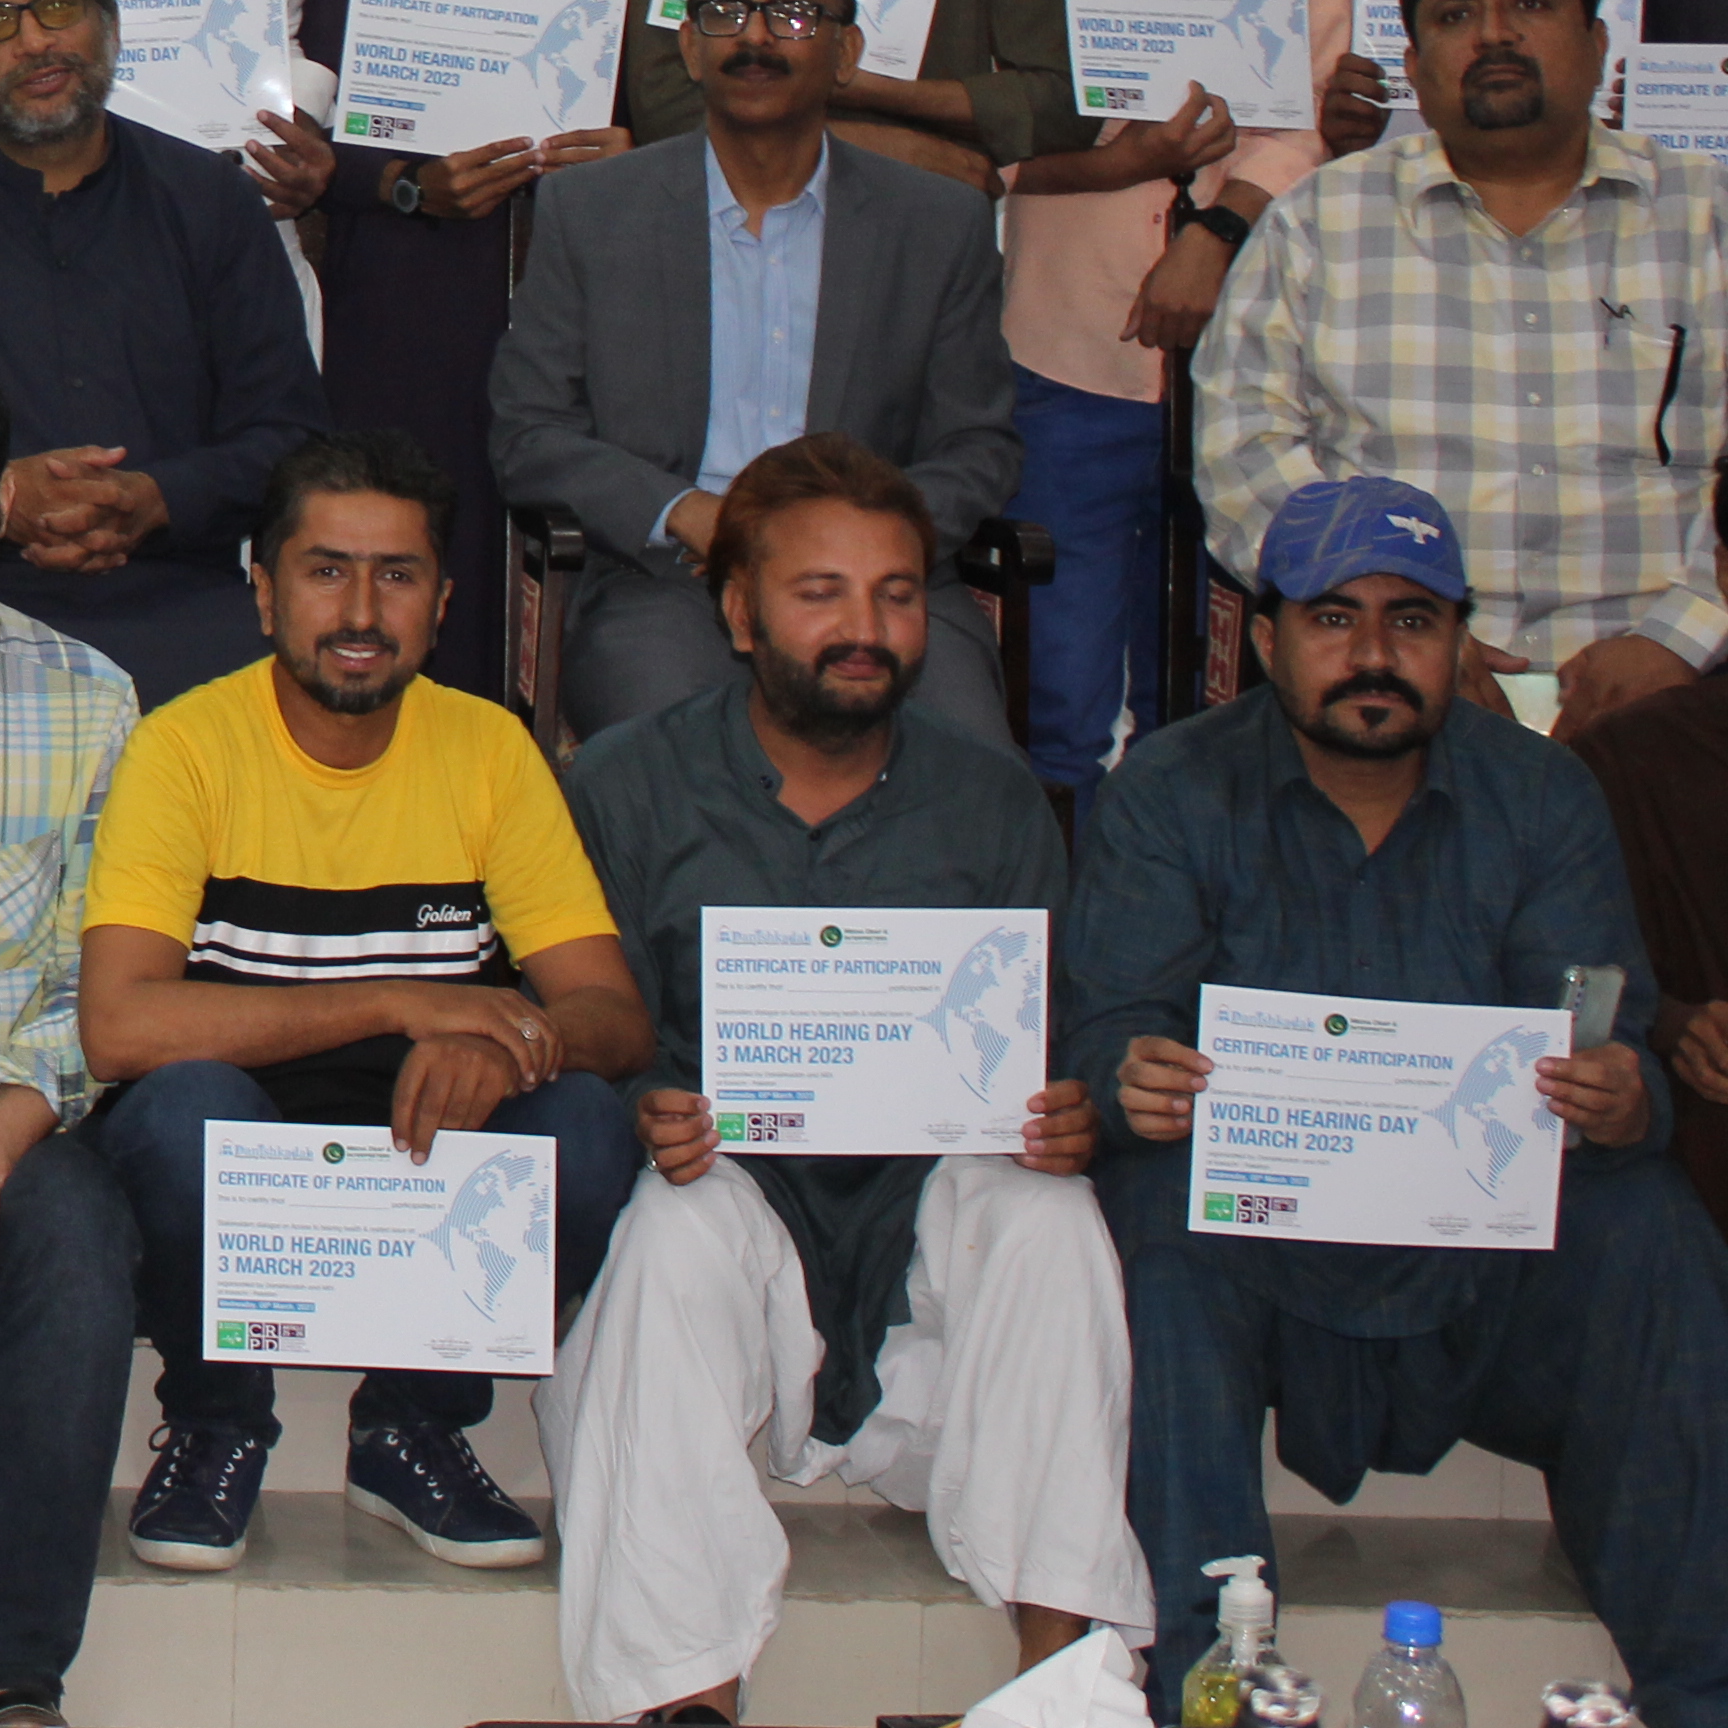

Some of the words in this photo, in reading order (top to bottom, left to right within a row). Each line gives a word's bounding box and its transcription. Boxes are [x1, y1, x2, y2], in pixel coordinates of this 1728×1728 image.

[152, 47, 180, 61] DAY
[355, 42, 406, 62] WORLD
[412, 51, 475, 71] HEARING
[480, 60, 510, 75] DAY
[367, 63, 420, 82] MARCH
[424, 71, 460, 87] 2023
[416, 904, 472, 928] Golden
[716, 959, 806, 973] CERTIFICATE
[812, 960, 829, 973] OF
[834, 960, 941, 974] PARTICIPATION
[717, 1022, 782, 1041] WORLD
[790, 1023, 869, 1041] HEARING
[876, 1024, 912, 1041] DAY
[717, 1046, 728, 1063] 3
[734, 1046, 801, 1063] MARCH
[808, 1047, 854, 1064] 2023
[1213, 1038, 1308, 1060] CERTIFICATE
[1313, 1048, 1333, 1062] OF
[1338, 1050, 1453, 1070] PARTICIPATION
[1210, 1102, 1279, 1124] WORLD
[1286, 1109, 1372, 1131] HEARING
[1379, 1116, 1418, 1134] DAY
[1208, 1125, 1220, 1142] 3
[1227, 1127, 1298, 1149] MARCH
[1305, 1134, 1354, 1153] 2023
[218, 1171, 308, 1189] CERTIFICATE
[313, 1176, 332, 1190] OF
[337, 1177, 445, 1193] PARTICIPATION
[218, 1232, 284, 1252] WORLD
[291, 1237, 372, 1256] HEARING
[378, 1240, 415, 1257] DAY
[218, 1256, 229, 1272] 3
[236, 1256, 302, 1276] MARCH
[309, 1260, 355, 1277] 2023
